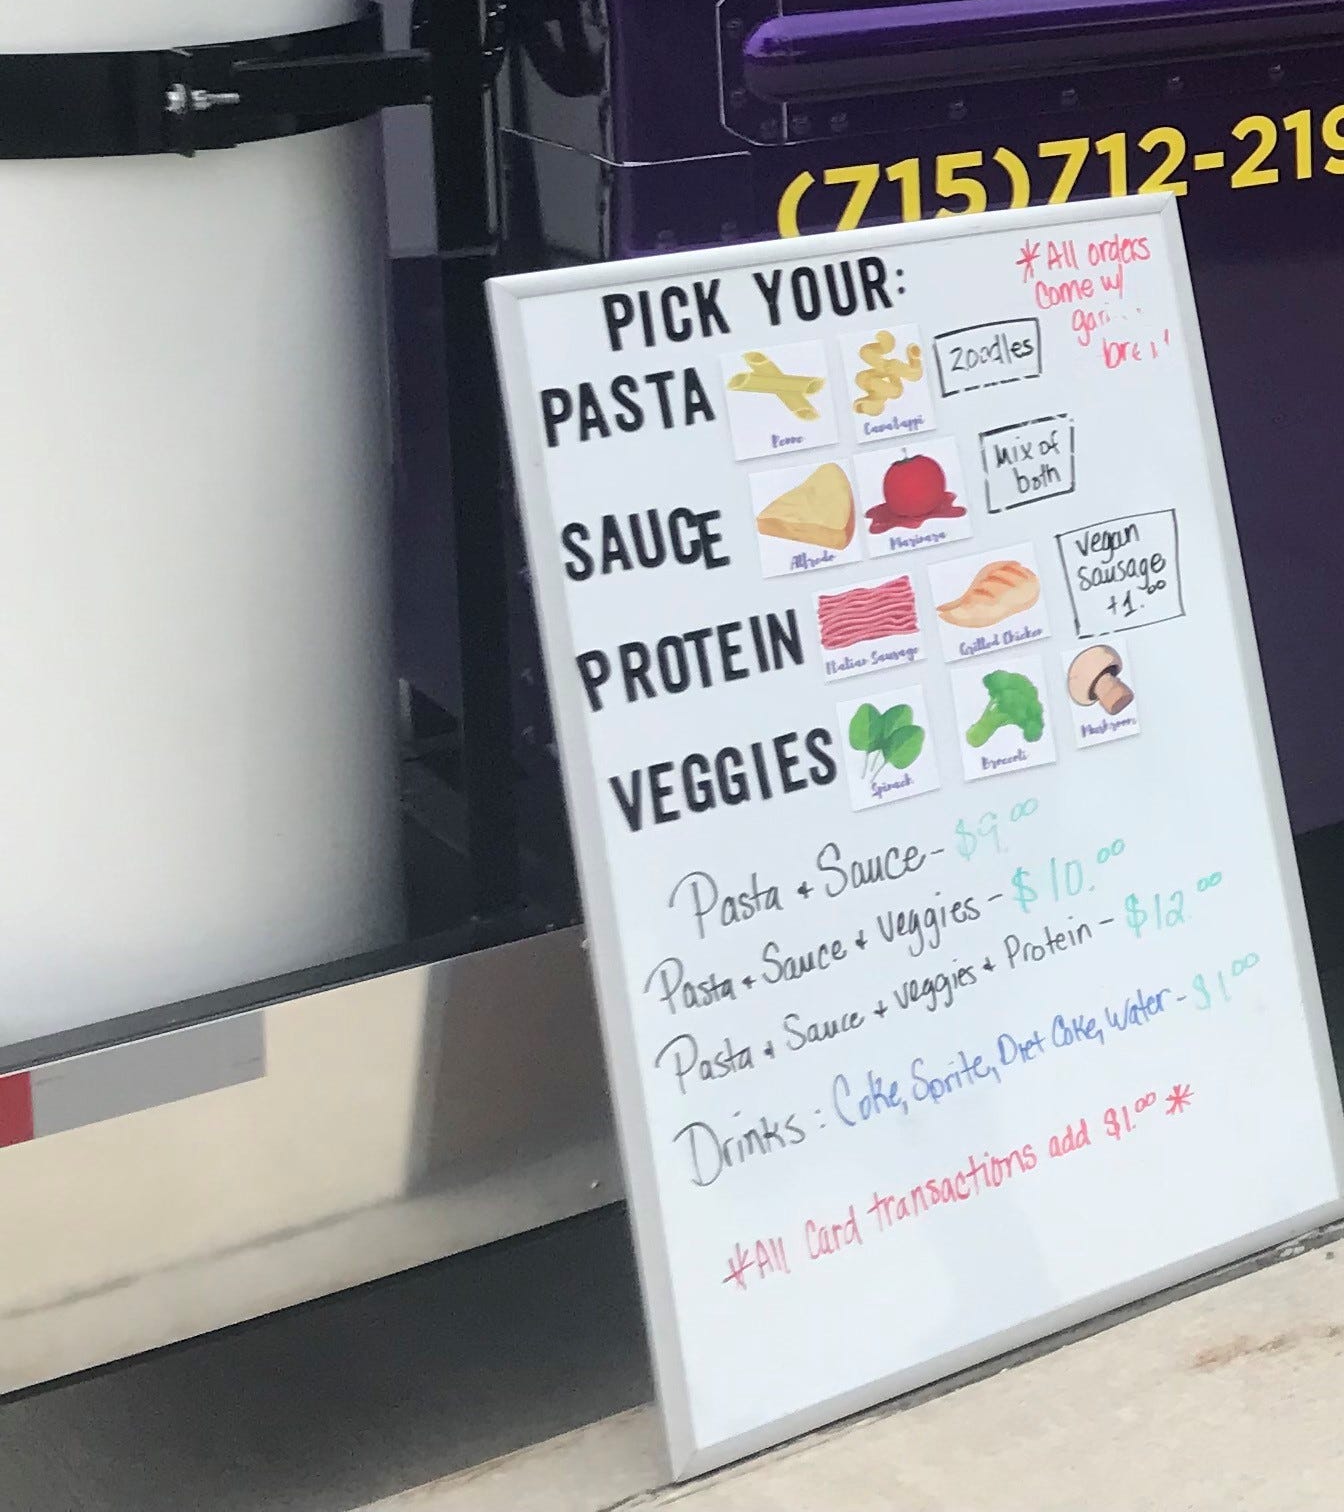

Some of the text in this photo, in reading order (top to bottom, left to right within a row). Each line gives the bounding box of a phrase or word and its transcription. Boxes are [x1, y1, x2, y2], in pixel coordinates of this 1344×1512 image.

[1088, 233, 1151, 267] orders
[601, 255, 906, 352] PICK YOUR:
[540, 366, 716, 448] PASTA
[1039, 429, 1062, 455] of
[1012, 463, 1062, 494] both
[561, 506, 731, 582] SAUCE
[575, 607, 805, 714] PROTEIN
[608, 726, 838, 833] VEGGIES
[667, 870, 784, 940] Pasta
[643, 955, 737, 1015] Pasta
[761, 940, 849, 985] Sauce
[654, 1032, 755, 1096] Pasta
[783, 1012, 866, 1052] Sauce
[1002, 914, 1093, 970] Protein
[804, 1204, 864, 1262] Card
[866, 1142, 1039, 1223] transactions
[1047, 1117, 1092, 1158] add
